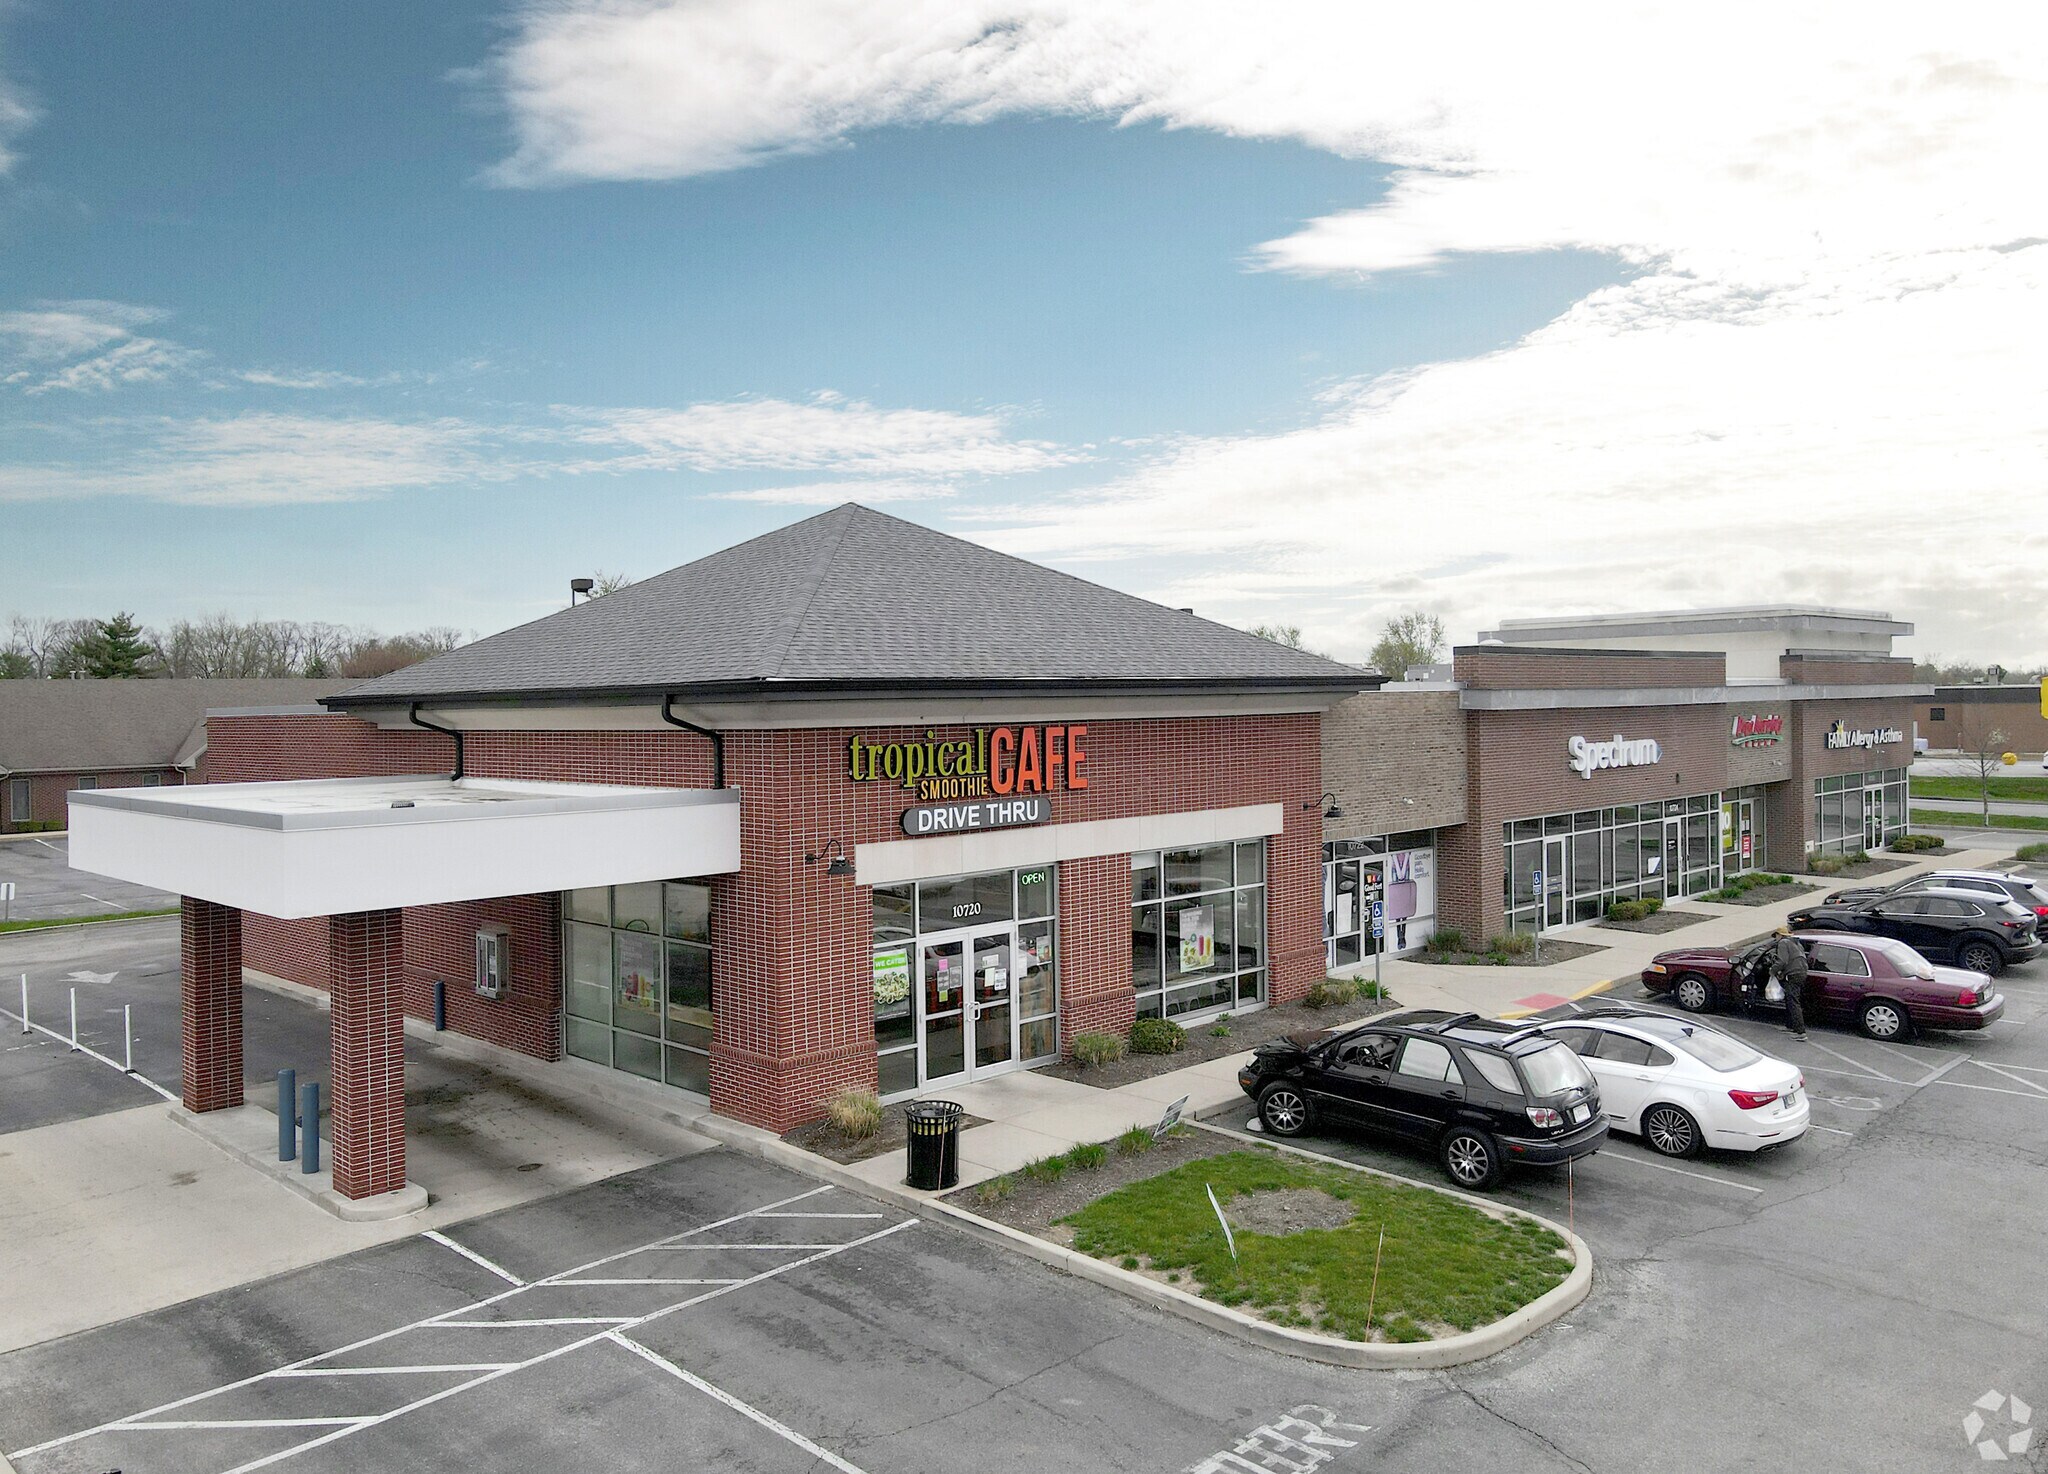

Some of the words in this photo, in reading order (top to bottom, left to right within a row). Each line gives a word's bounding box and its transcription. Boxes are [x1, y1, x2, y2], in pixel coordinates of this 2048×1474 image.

[1827, 731, 1851, 749] FAMILY
[1851, 729, 1874, 749] Allergy
[1880, 727, 1903, 743] Asthma
[849, 728, 987, 788] tropical
[989, 726, 1089, 794] CAFE
[1568, 734, 1659, 780] Spectrum
[920, 777, 988, 800] SMOOTHIE
[918, 805, 981, 832] DRIVE
[987, 800, 1039, 824] THRU
[1022, 871, 1046, 886] OPEN
[952, 902, 982, 919] 10720
